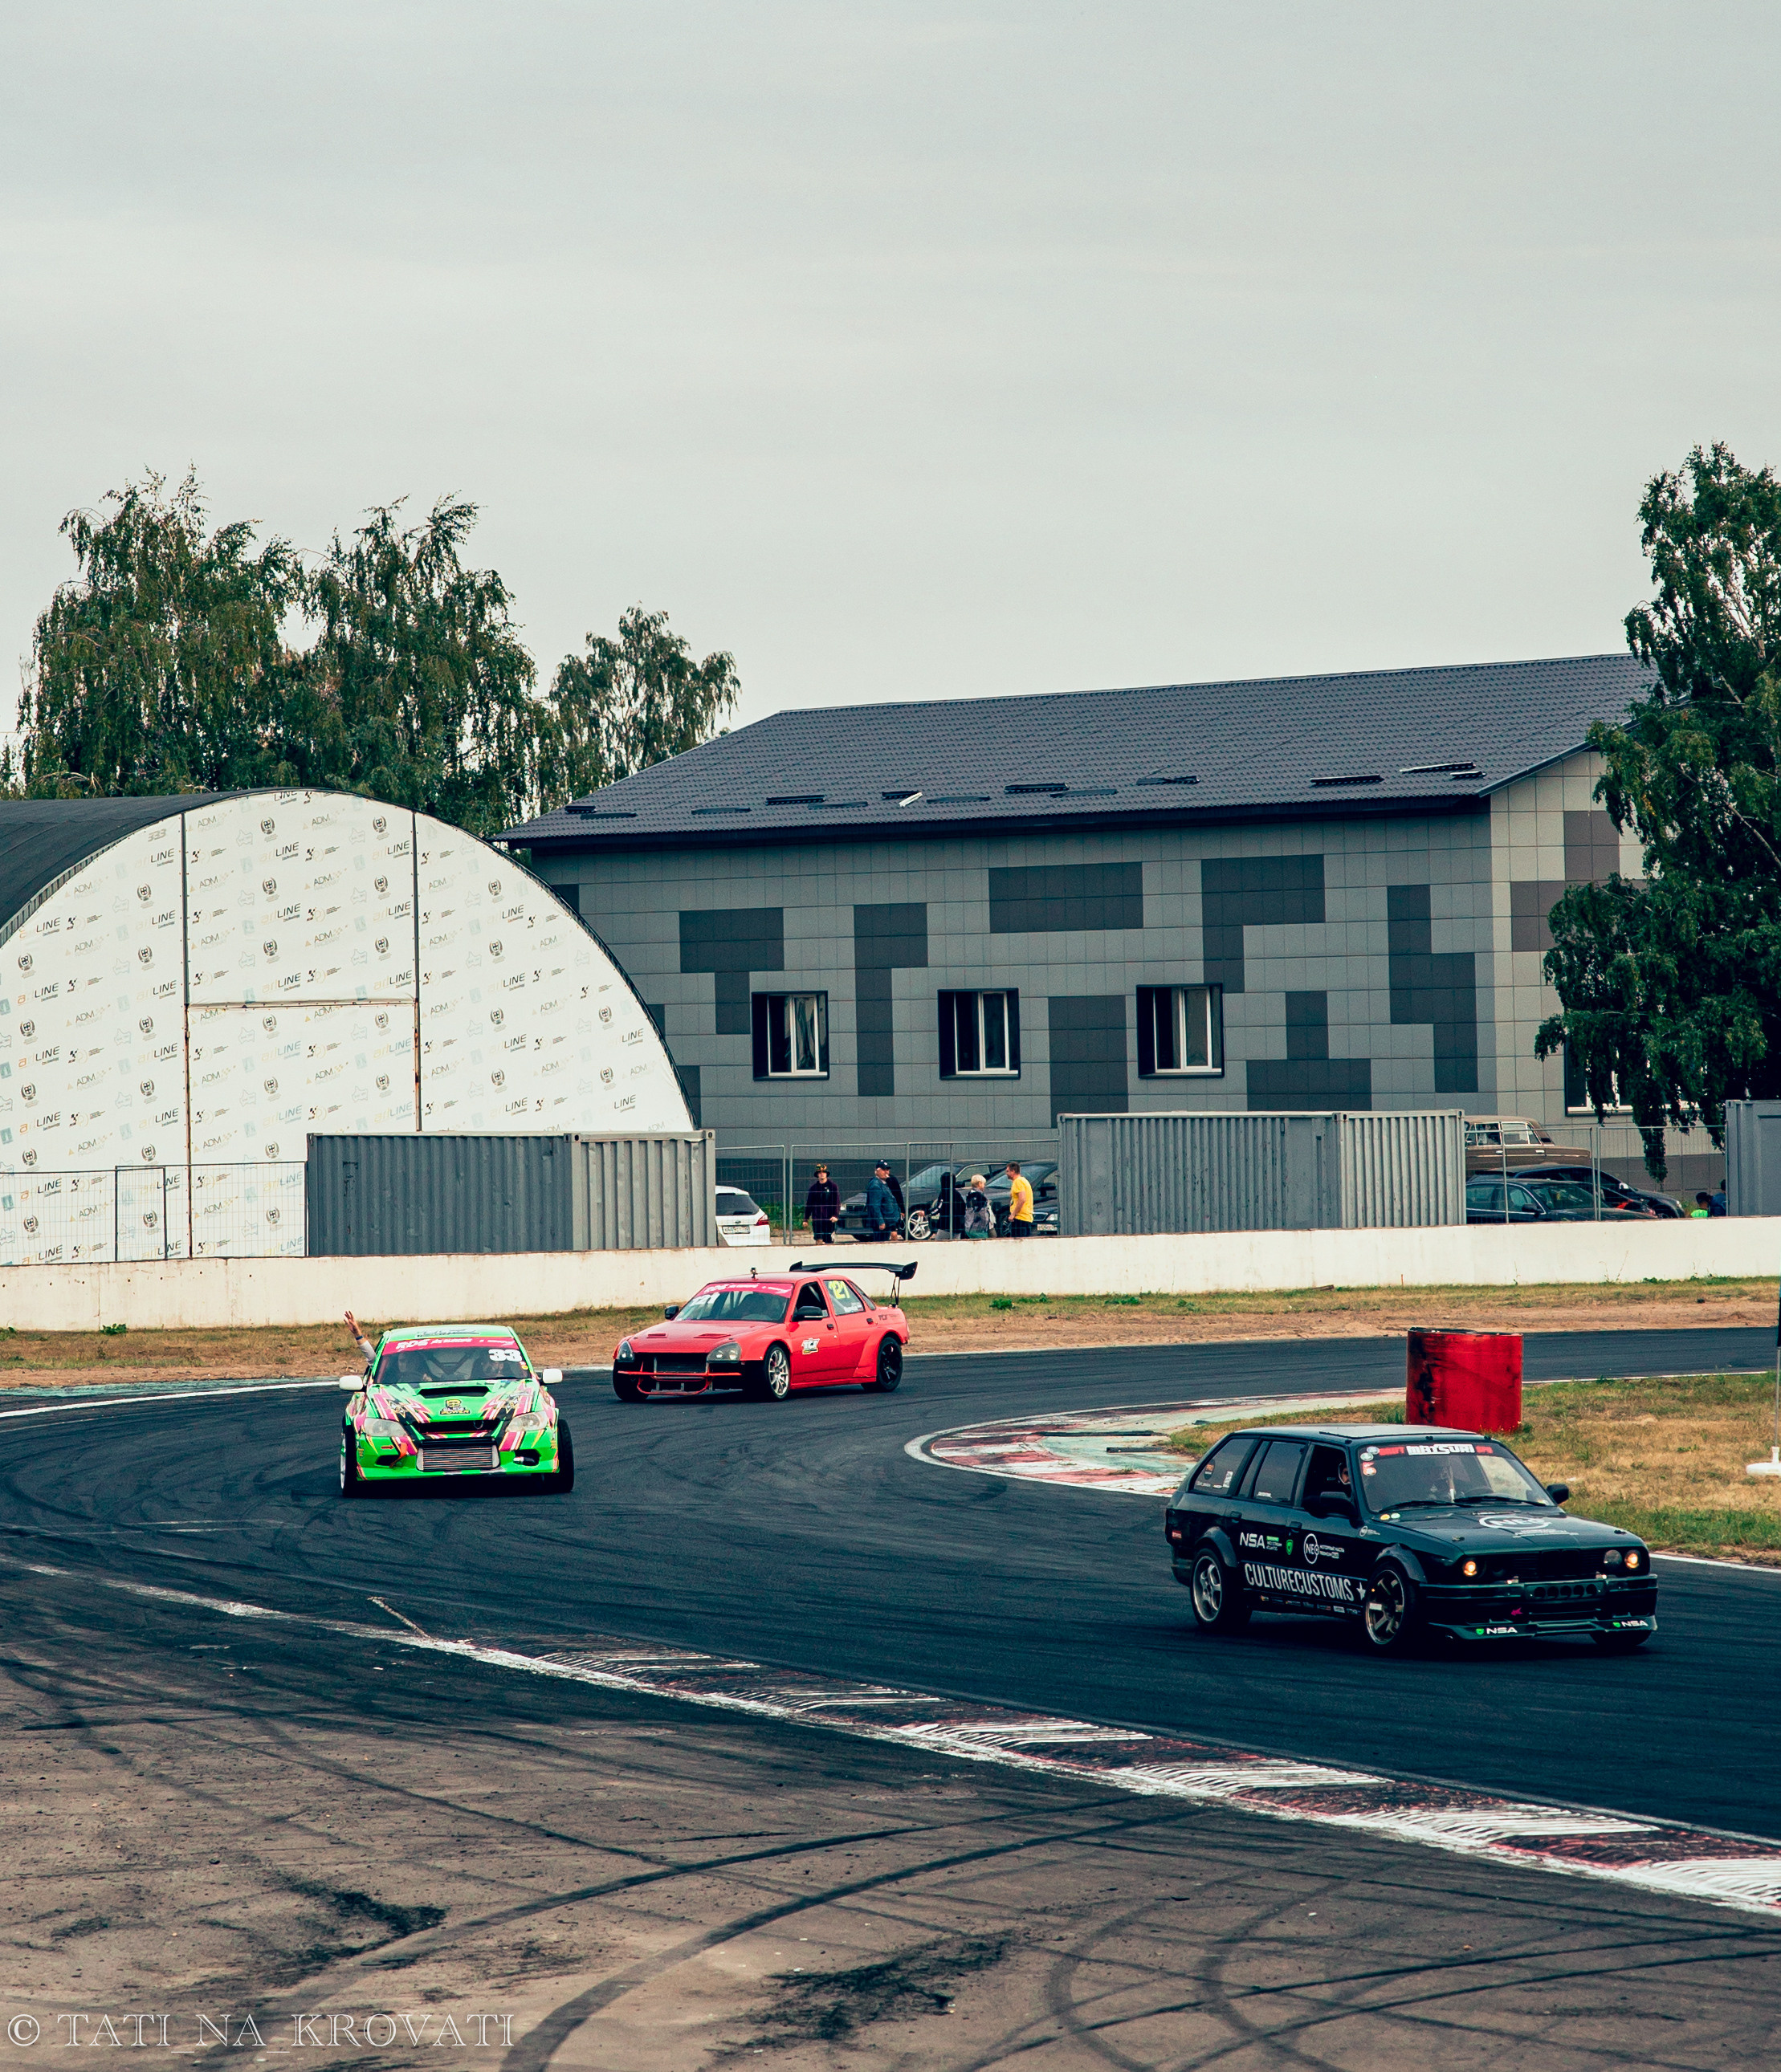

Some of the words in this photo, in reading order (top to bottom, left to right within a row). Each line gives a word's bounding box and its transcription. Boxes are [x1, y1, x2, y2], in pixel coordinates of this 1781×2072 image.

[488, 1349, 523, 1362] 33
[1240, 1532, 1265, 1549] NSA
[1244, 1563, 1355, 1602] CULTURECUSTOMS
[1486, 1626, 1518, 1634] NSA
